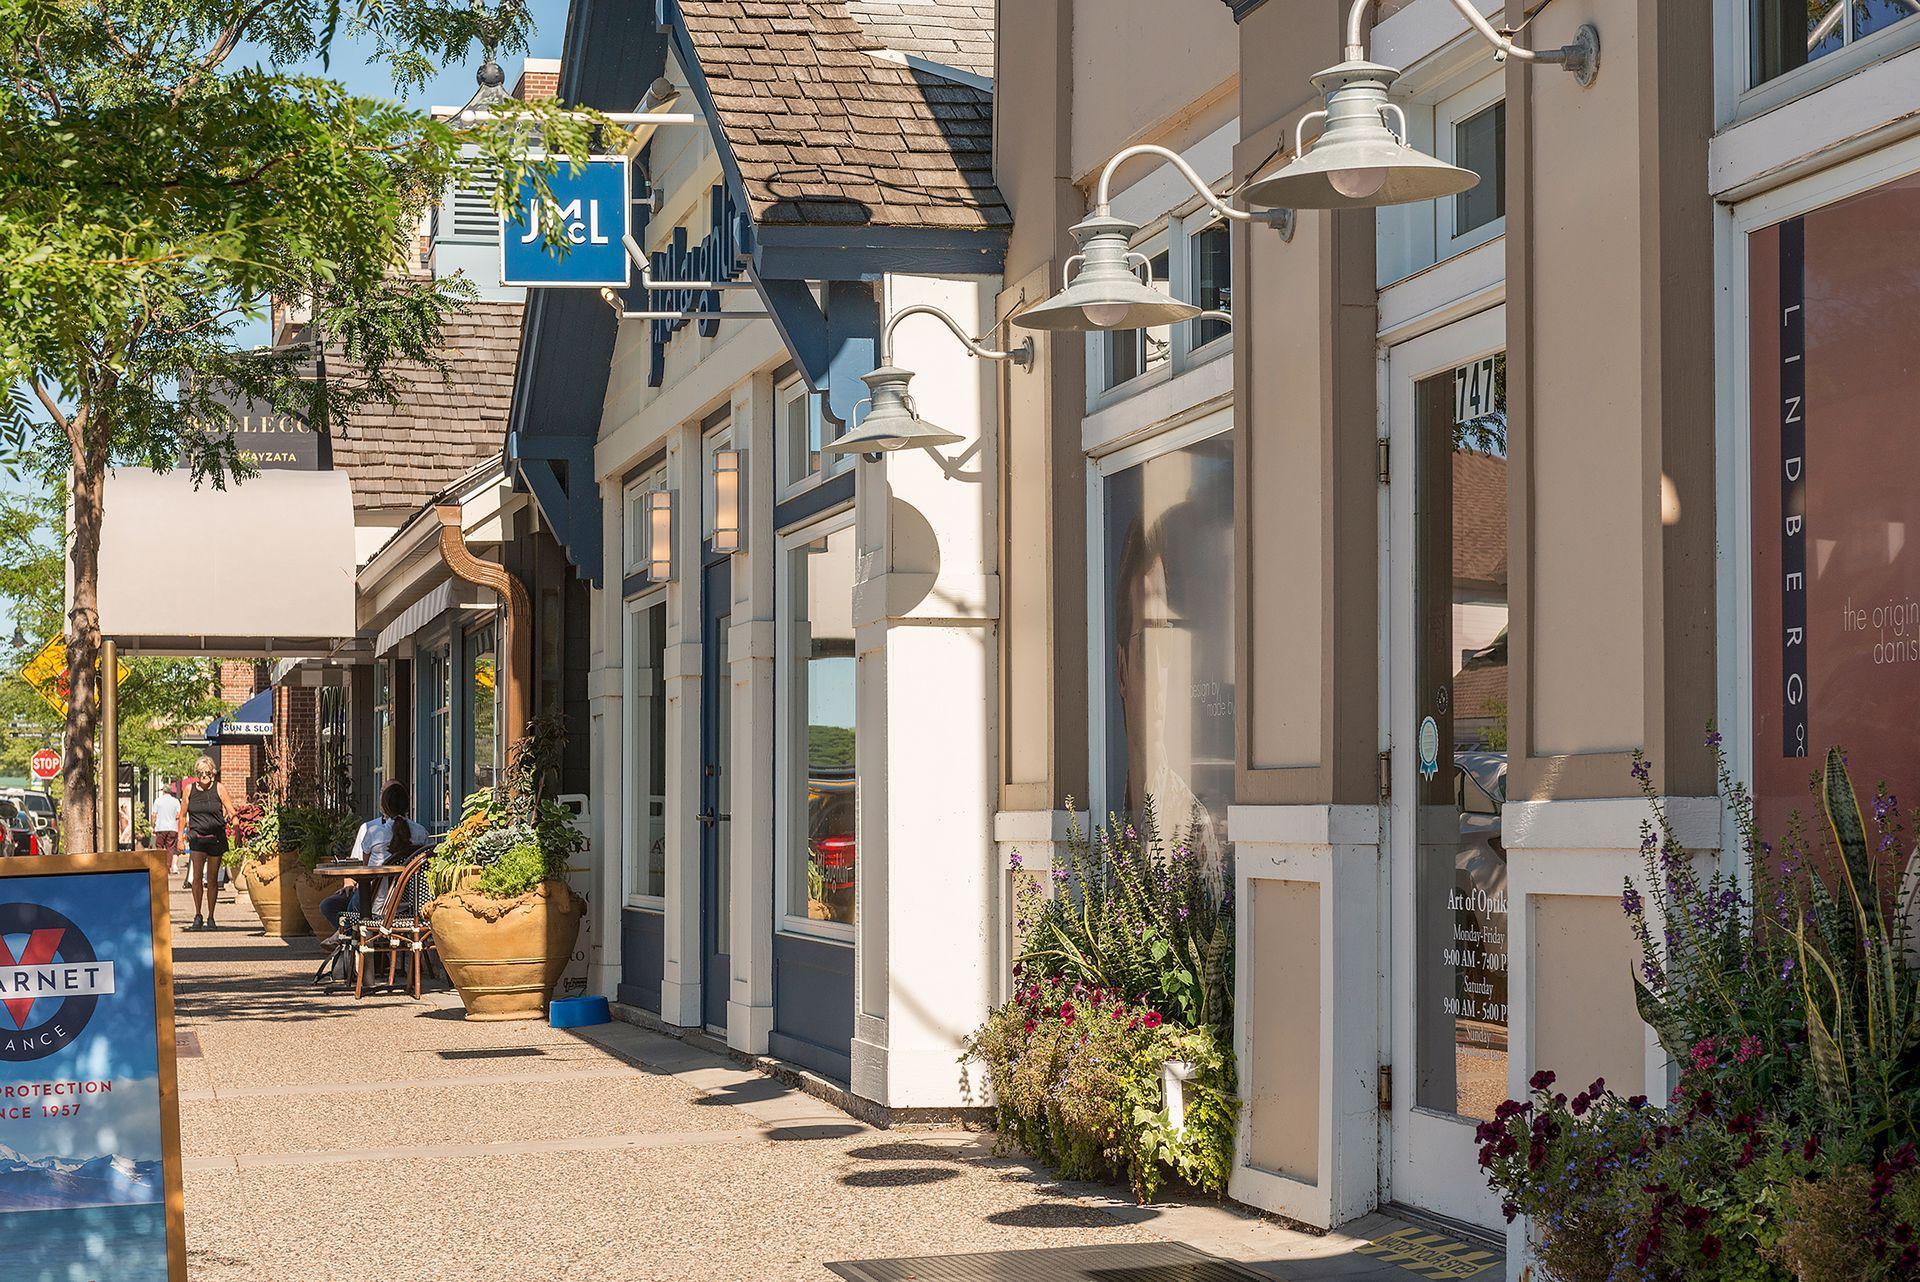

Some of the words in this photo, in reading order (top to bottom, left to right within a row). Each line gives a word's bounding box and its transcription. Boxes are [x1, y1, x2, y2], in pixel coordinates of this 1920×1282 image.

[1457, 358, 1493, 421] 747
[1784, 304, 1804, 706] LINDBERG
[1843, 596, 1867, 632] the
[223, 724, 242, 732] SUN
[244, 724, 251, 732] &
[33, 757, 60, 770] STOP
[1447, 888, 1463, 911] Art
[1465, 887, 1477, 911] of
[1478, 889, 1508, 920] Optik
[1453, 924, 1506, 950] Monday-Friday
[1443, 948, 1460, 966] 9:00
[1461, 950, 1475, 968] AM
[1482, 952, 1499, 971] 7:00
[1501, 953, 1508, 972] P
[1464, 975, 1493, 1000] Saturday
[1443, 996, 1460, 1015] 9:00
[1461, 999, 1475, 1018] AM
[1482, 1002, 1499, 1021] 5:00
[1501, 1004, 1508, 1023] P
[5, 1024, 66, 1051] ANCE
[1466, 1023, 1492, 1049] Sunday
[42, 1103, 81, 1118] 1957
